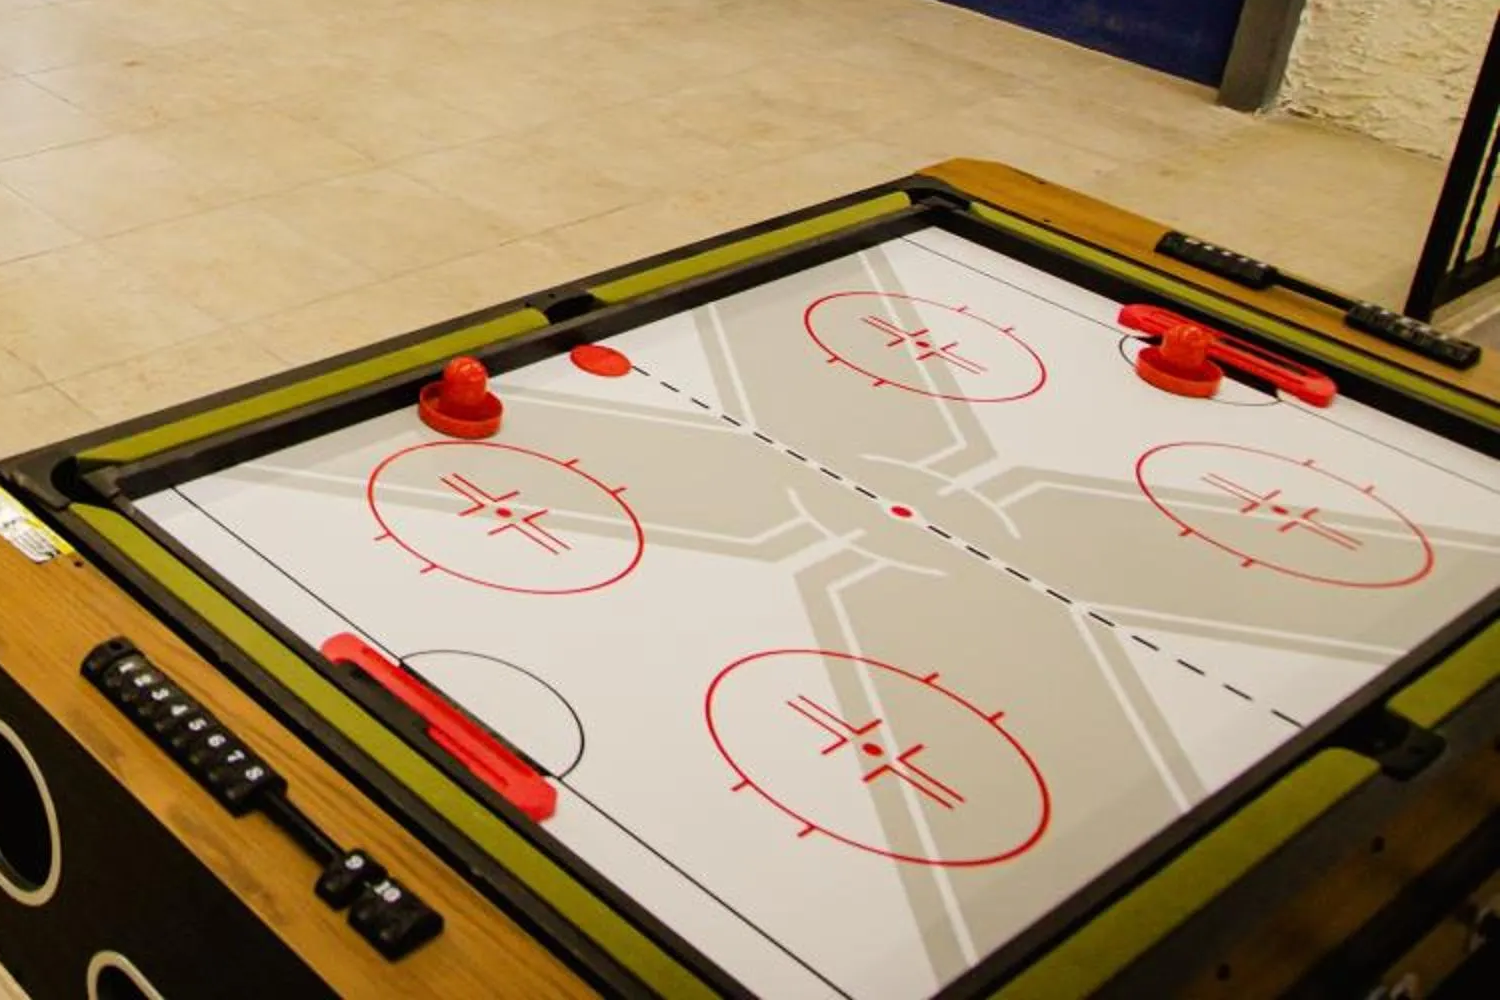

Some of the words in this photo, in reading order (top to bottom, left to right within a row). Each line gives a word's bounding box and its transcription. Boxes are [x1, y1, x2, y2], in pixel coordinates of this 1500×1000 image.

[152, 688, 170, 700] 3
[171, 704, 188, 716] 4
[188, 717, 207, 731] 5
[207, 734, 226, 747] 6
[227, 750, 245, 762] 7
[245, 766, 264, 781] 8
[345, 855, 364, 870] 9
[373, 880, 401, 902] 10
